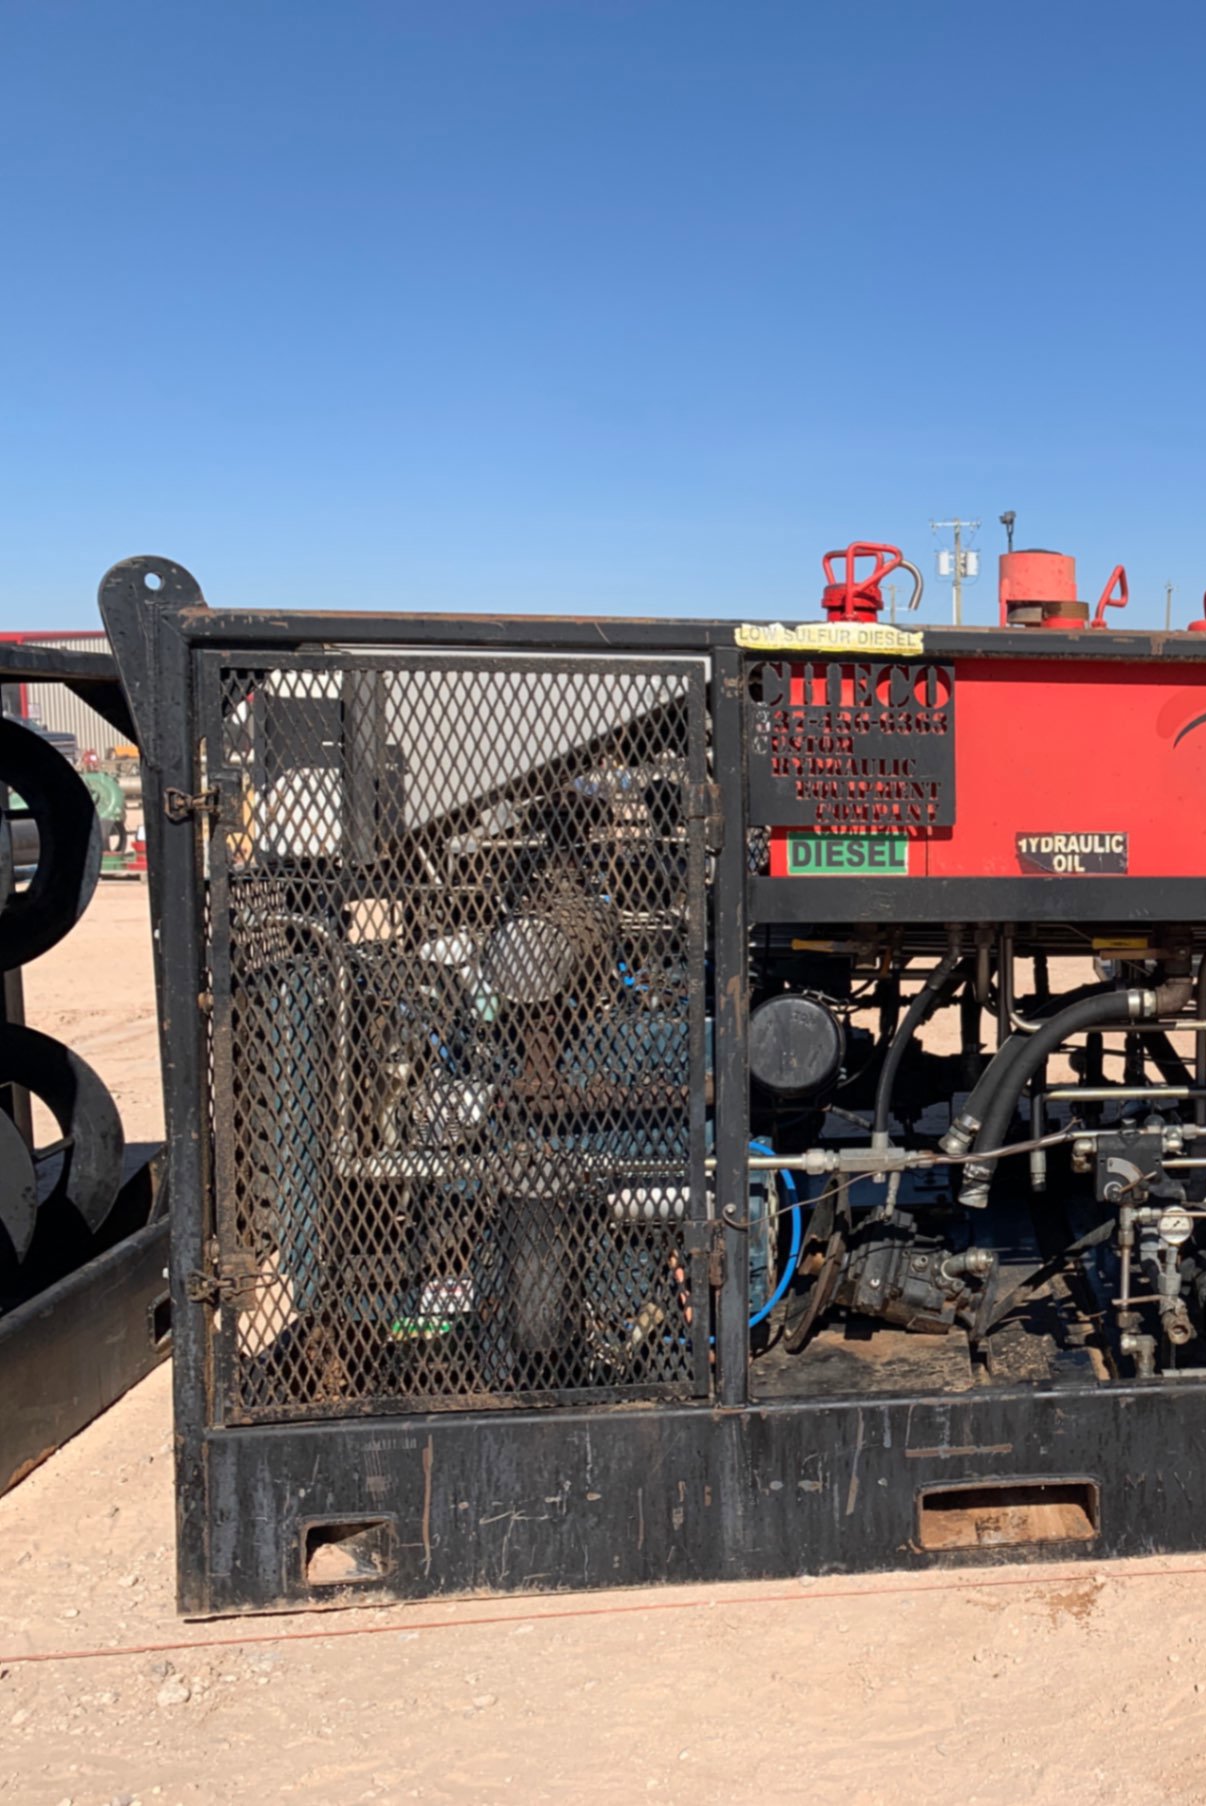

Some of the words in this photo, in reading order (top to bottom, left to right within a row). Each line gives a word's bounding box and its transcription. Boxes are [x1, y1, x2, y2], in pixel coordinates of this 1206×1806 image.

[740, 627, 776, 641] LOW
[783, 628, 851, 645] SULFUR
[857, 631, 916, 646] DIESEL
[749, 662, 951, 710] CHECO
[754, 735, 855, 755] CUSTOM
[771, 757, 917, 778] HYDRAULIC
[796, 780, 942, 801] EQUIPMENT
[815, 803, 941, 824] COMPANY
[791, 840, 905, 867] DIESEL
[1052, 854, 1086, 872] OIL
